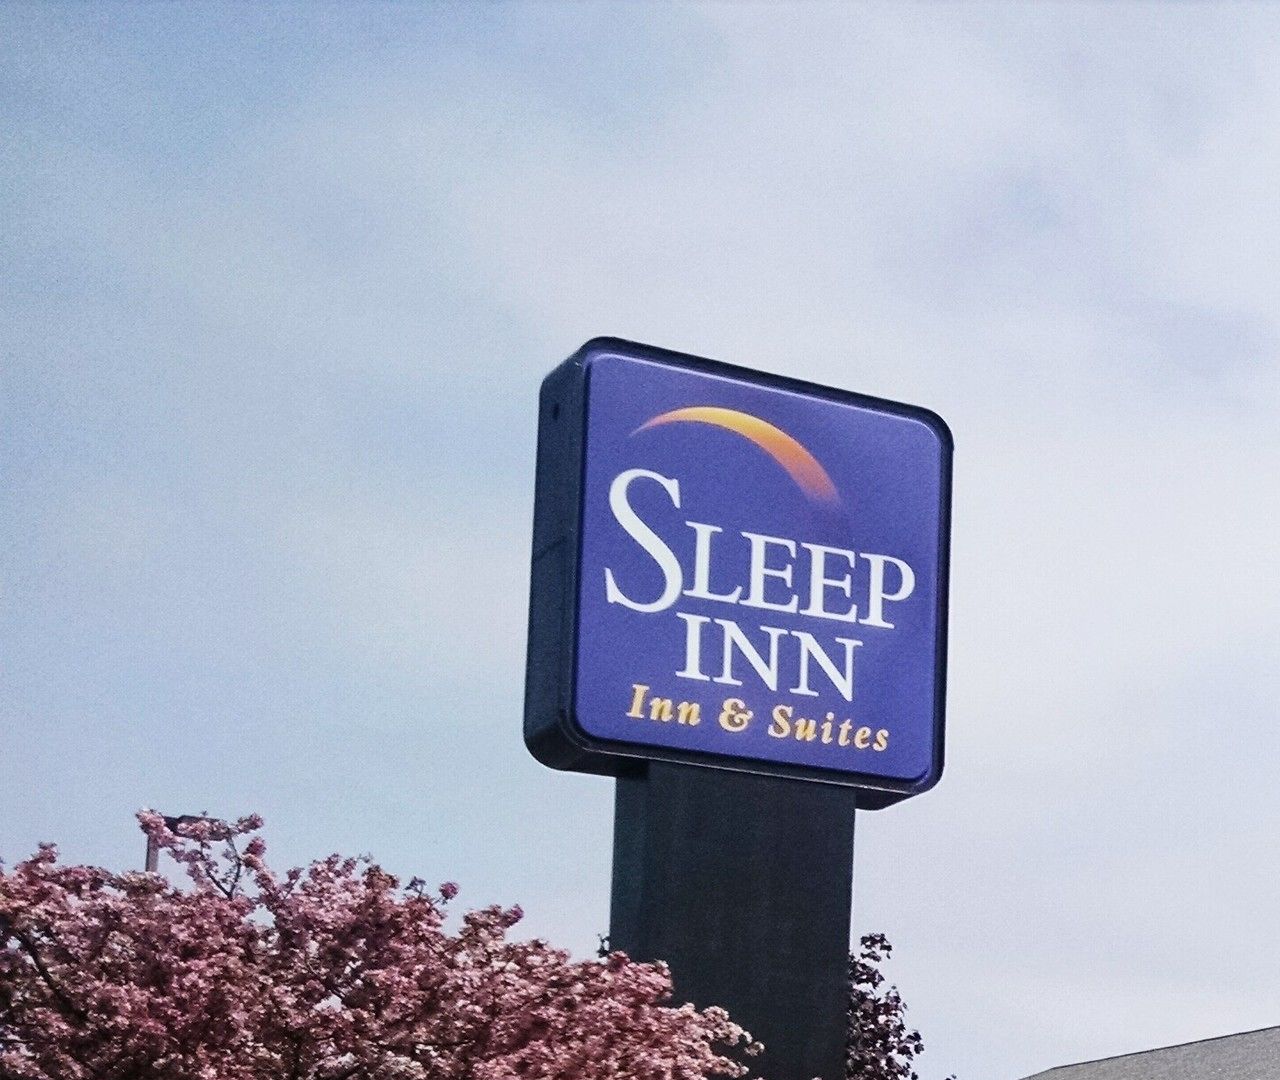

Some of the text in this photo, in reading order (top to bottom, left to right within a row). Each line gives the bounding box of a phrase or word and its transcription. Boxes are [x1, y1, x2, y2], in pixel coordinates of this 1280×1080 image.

[604, 468, 916, 629] SLEEP
[675, 611, 863, 703] INN
[626, 683, 890, 752] Inn & Suites
